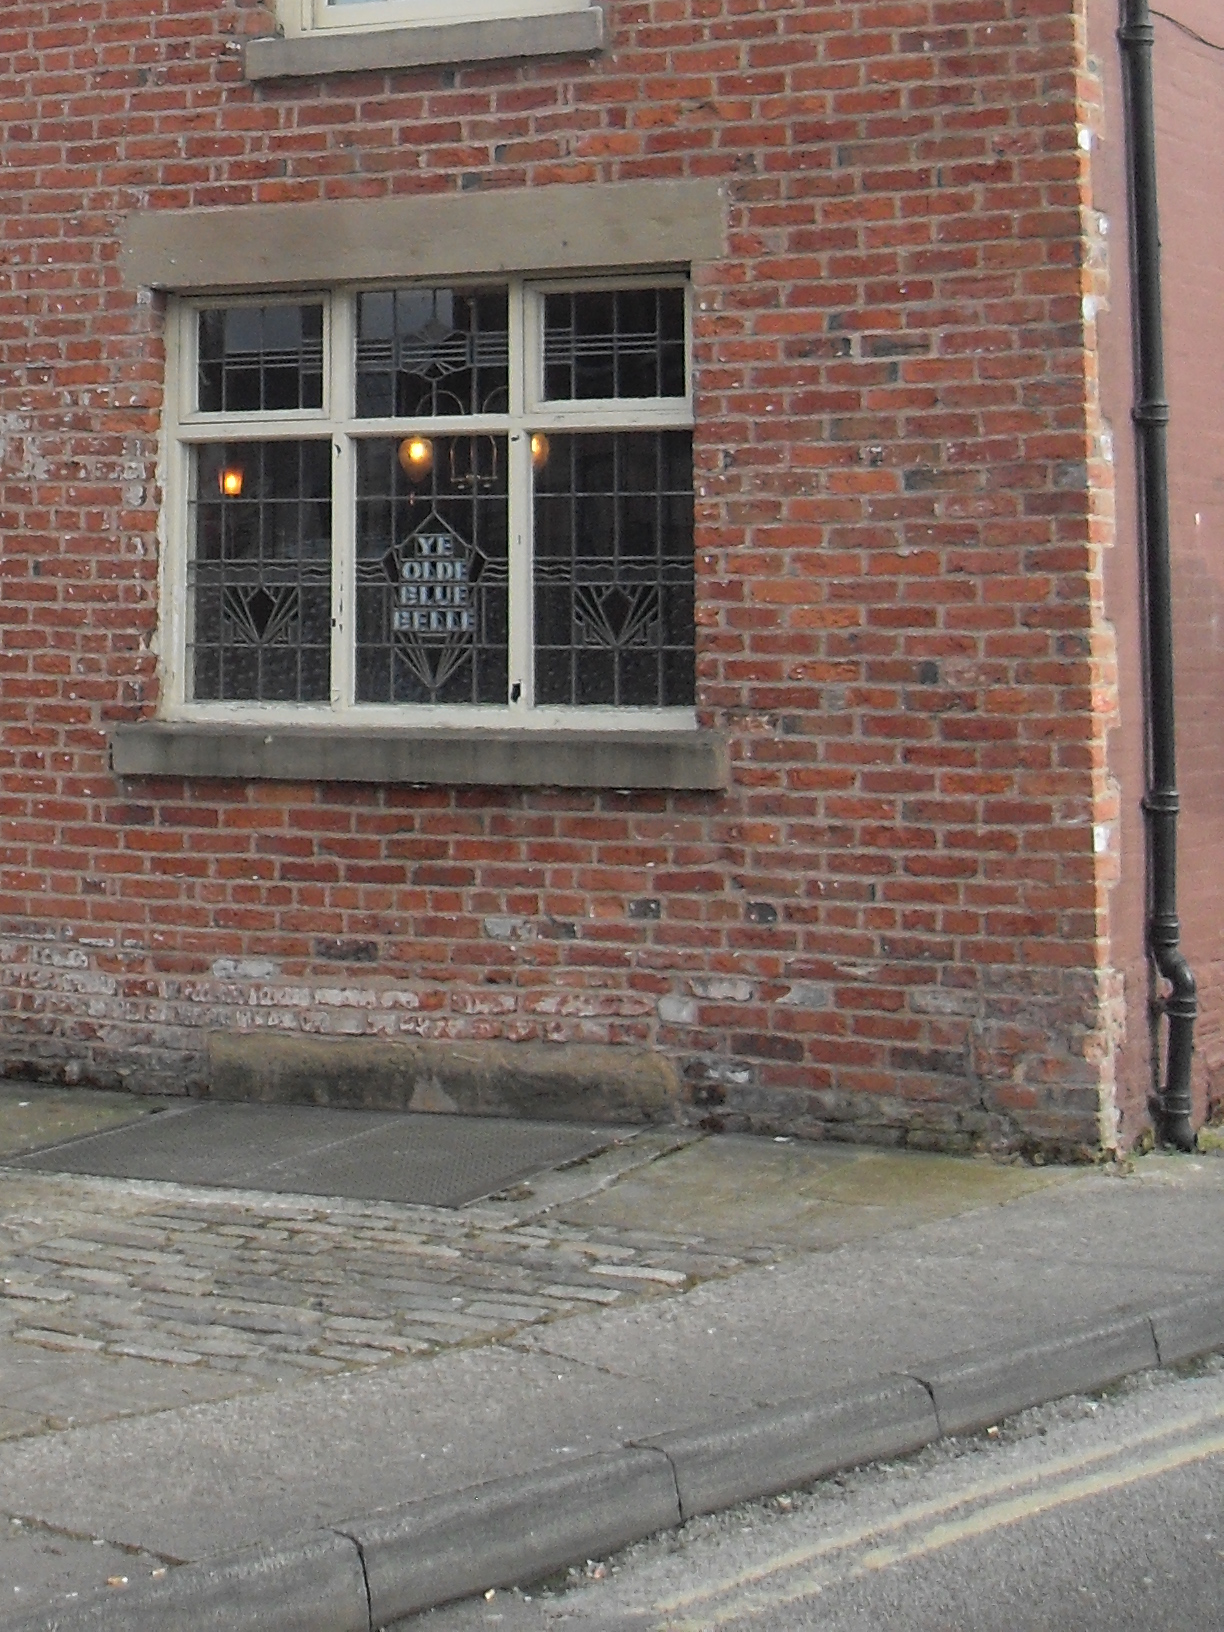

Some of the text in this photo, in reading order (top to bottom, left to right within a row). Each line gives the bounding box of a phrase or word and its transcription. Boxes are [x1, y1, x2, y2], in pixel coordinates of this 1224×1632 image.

[417, 536, 454, 556] YE
[401, 561, 469, 581] OLDE
[400, 586, 469, 606] BLUE
